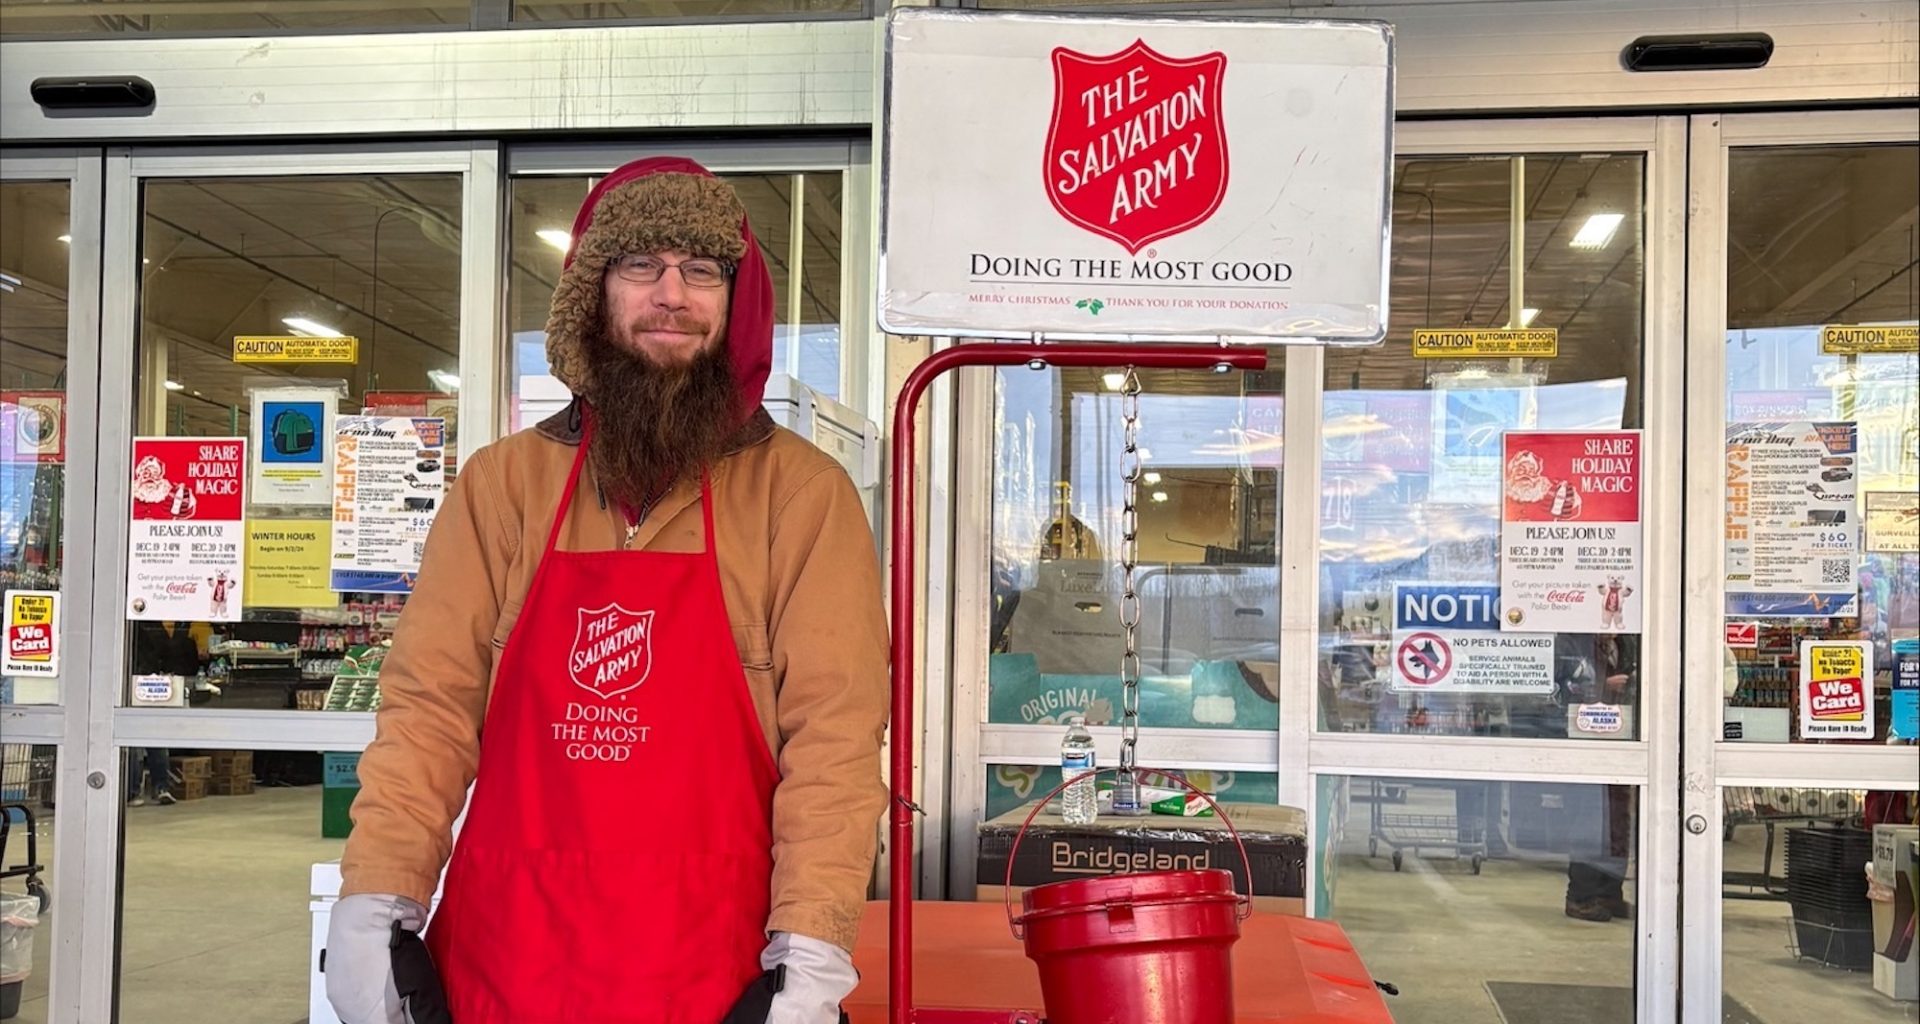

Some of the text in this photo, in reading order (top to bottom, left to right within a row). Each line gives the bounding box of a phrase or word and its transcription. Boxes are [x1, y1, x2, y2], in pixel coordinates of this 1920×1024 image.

[1081, 65, 1149, 128] THE
[1058, 74, 1206, 195] SALVATION
[1109, 132, 1203, 225] ARMY
[970, 253, 1293, 282] DOING THE MOST GOOD
[968, 294, 1288, 310] MERRY CHRISTMAS THANK YOU FOR YOUR DONATION
[1418, 332, 1555, 346] CAUTION AUTOMATIC DOOR
[1827, 330, 1885, 343] CAUTION
[237, 341, 283, 353] CAUTION
[286, 340, 328, 348] AUTOMATIC
[199, 445, 239, 461] SHARE
[1584, 439, 1633, 455] SHARE
[188, 462, 239, 477] HOLIDAY
[1571, 457, 1633, 474] HOLIDAY
[335, 436, 357, 522] RAFFLE
[1581, 476, 1633, 493] MAGIC
[195, 479, 239, 495] MAGIC
[1726, 445, 1749, 539] RAFFLE
[149, 525, 224, 537] PLEASE JOIN US!
[251, 532, 316, 540] WINTER HOURS
[1526, 527, 1616, 540] PLEASE JOIN US!
[1820, 532, 1847, 542] $60
[1510, 546, 1529, 556] DEC.
[1530, 546, 1539, 556] 19
[1577, 546, 1597, 556] DEC.
[1598, 546, 1608, 556] 20
[165, 573, 186, 581] picture
[186, 573, 203, 581] taken
[1511, 580, 1527, 588] Get
[1528, 582, 1544, 590] your
[1545, 581, 1571, 590] picture
[1517, 591, 1533, 599] with
[1534, 591, 1544, 599] the
[1531, 602, 1550, 610] Polar
[17, 626, 44, 639] We
[587, 611, 620, 642] THE
[11, 636, 50, 652] Card
[573, 617, 647, 673] SALVATION
[1453, 639, 1552, 648] NO PETS ALLOWED
[594, 645, 643, 687] ARMY
[1829, 658, 1855, 666] Tobacco
[1822, 667, 1852, 676] No Vapor
[1819, 681, 1853, 695] We
[1812, 694, 1861, 711] Card
[565, 702, 638, 723] DOING
[551, 723, 650, 742] THE MOST
[1808, 725, 1827, 733] Please
[1851, 725, 1867, 733] Ready
[1052, 841, 1210, 872] Bridgeland
